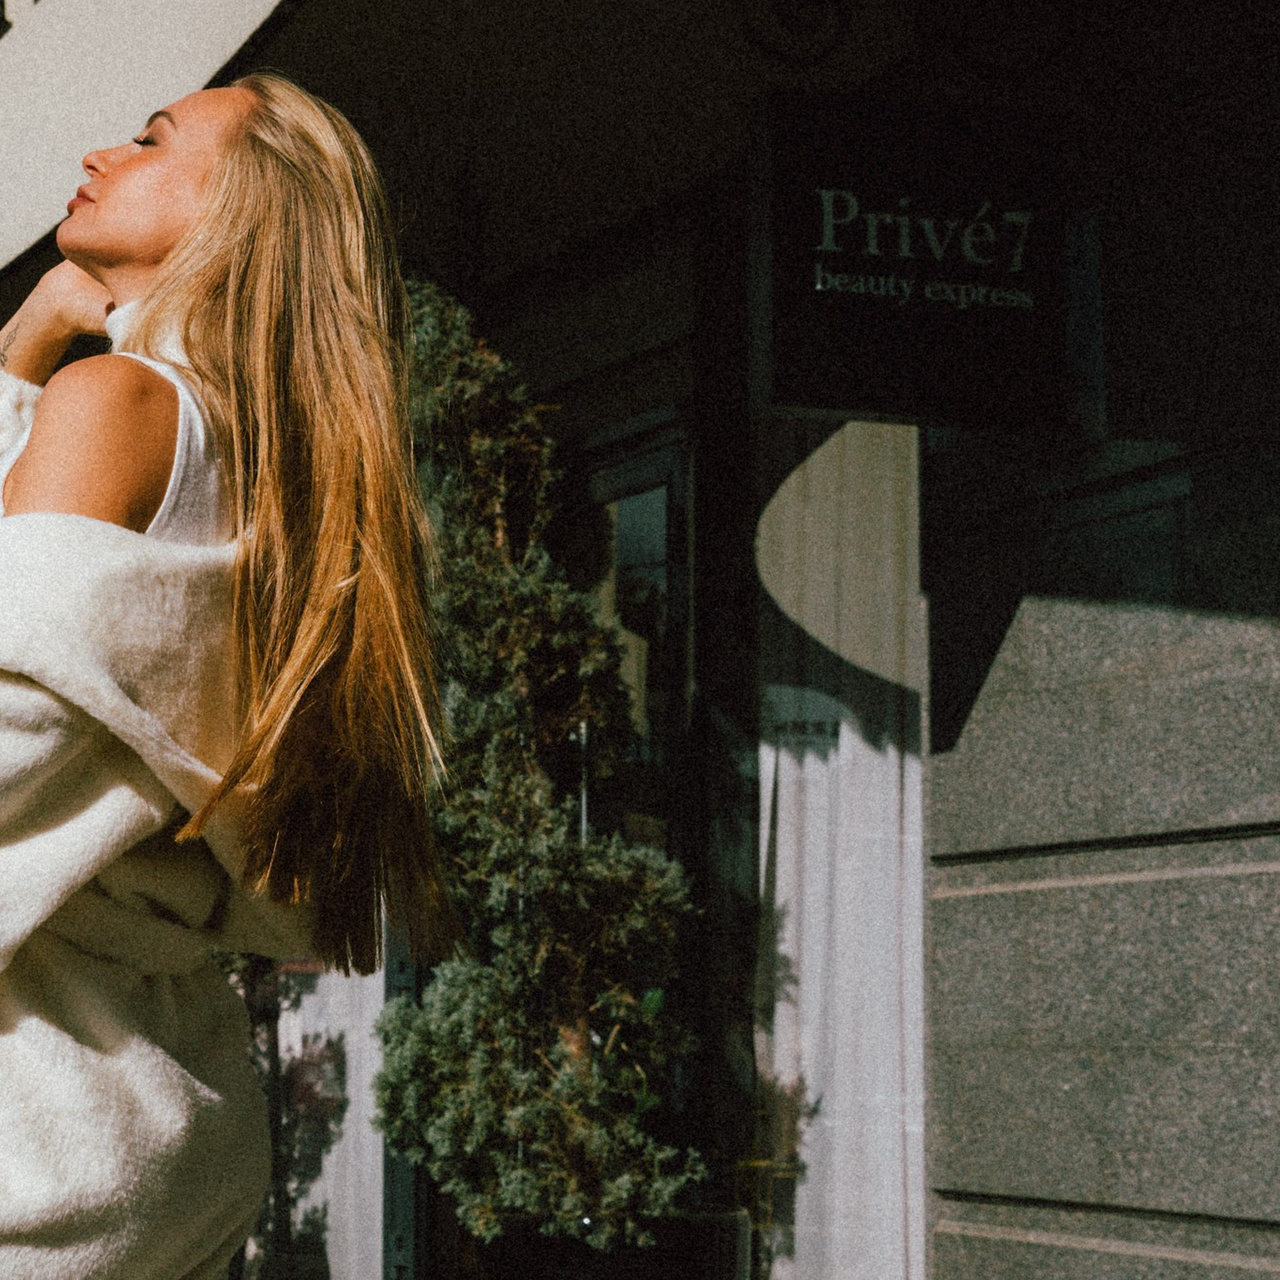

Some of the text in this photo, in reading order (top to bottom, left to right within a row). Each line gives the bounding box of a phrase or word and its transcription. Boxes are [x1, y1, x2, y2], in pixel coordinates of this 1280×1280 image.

[814, 188, 1033, 272] Privé7
[814, 262, 1035, 310] beauty express
